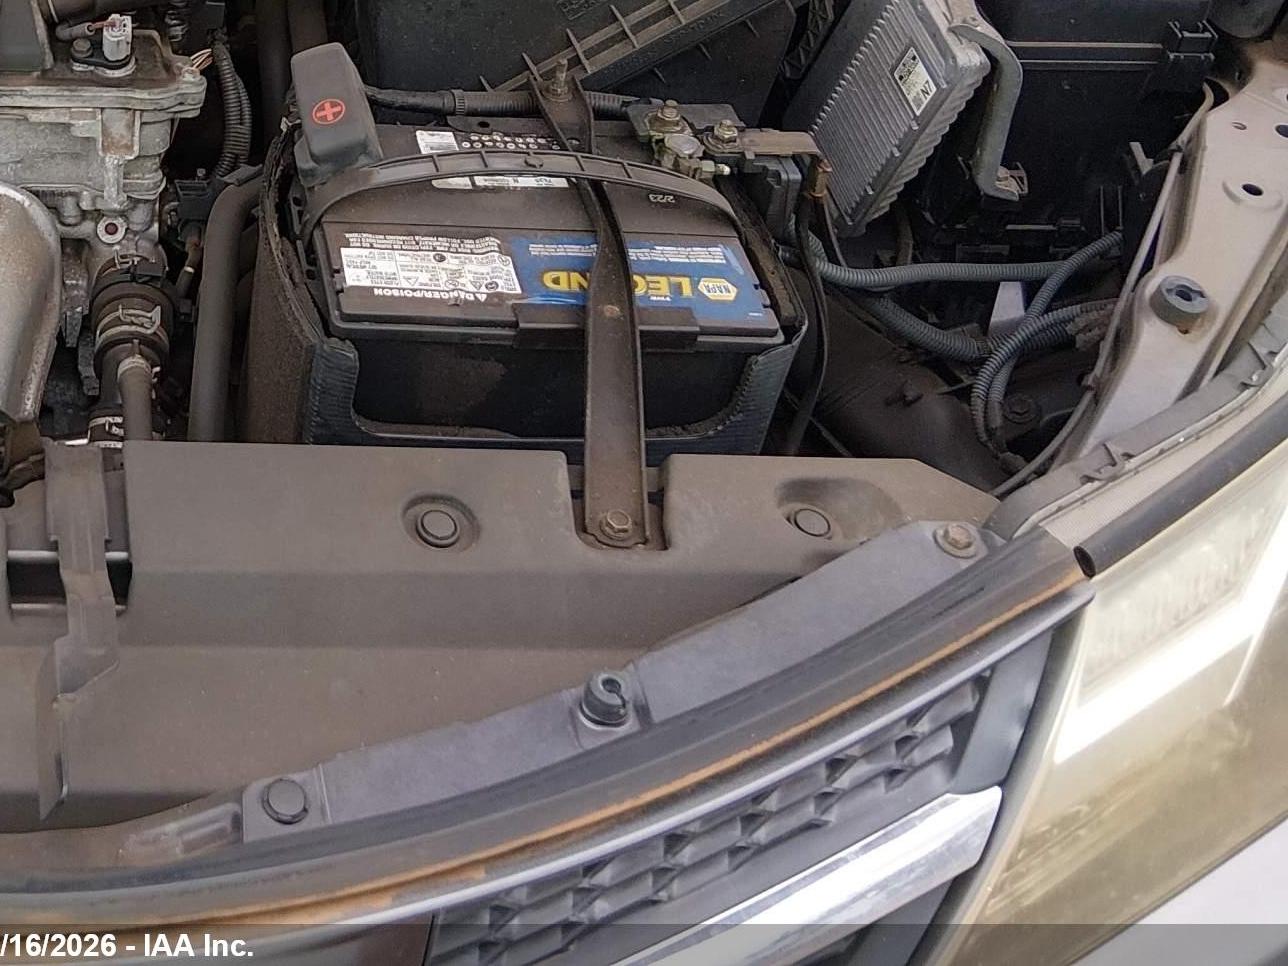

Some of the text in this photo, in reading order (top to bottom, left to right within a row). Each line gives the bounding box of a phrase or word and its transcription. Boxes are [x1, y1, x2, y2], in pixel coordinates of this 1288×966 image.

[542, 270, 693, 298] LEGND
[703, 282, 732, 295] NAPA
[373, 288, 477, 300] DANGER/POISON
